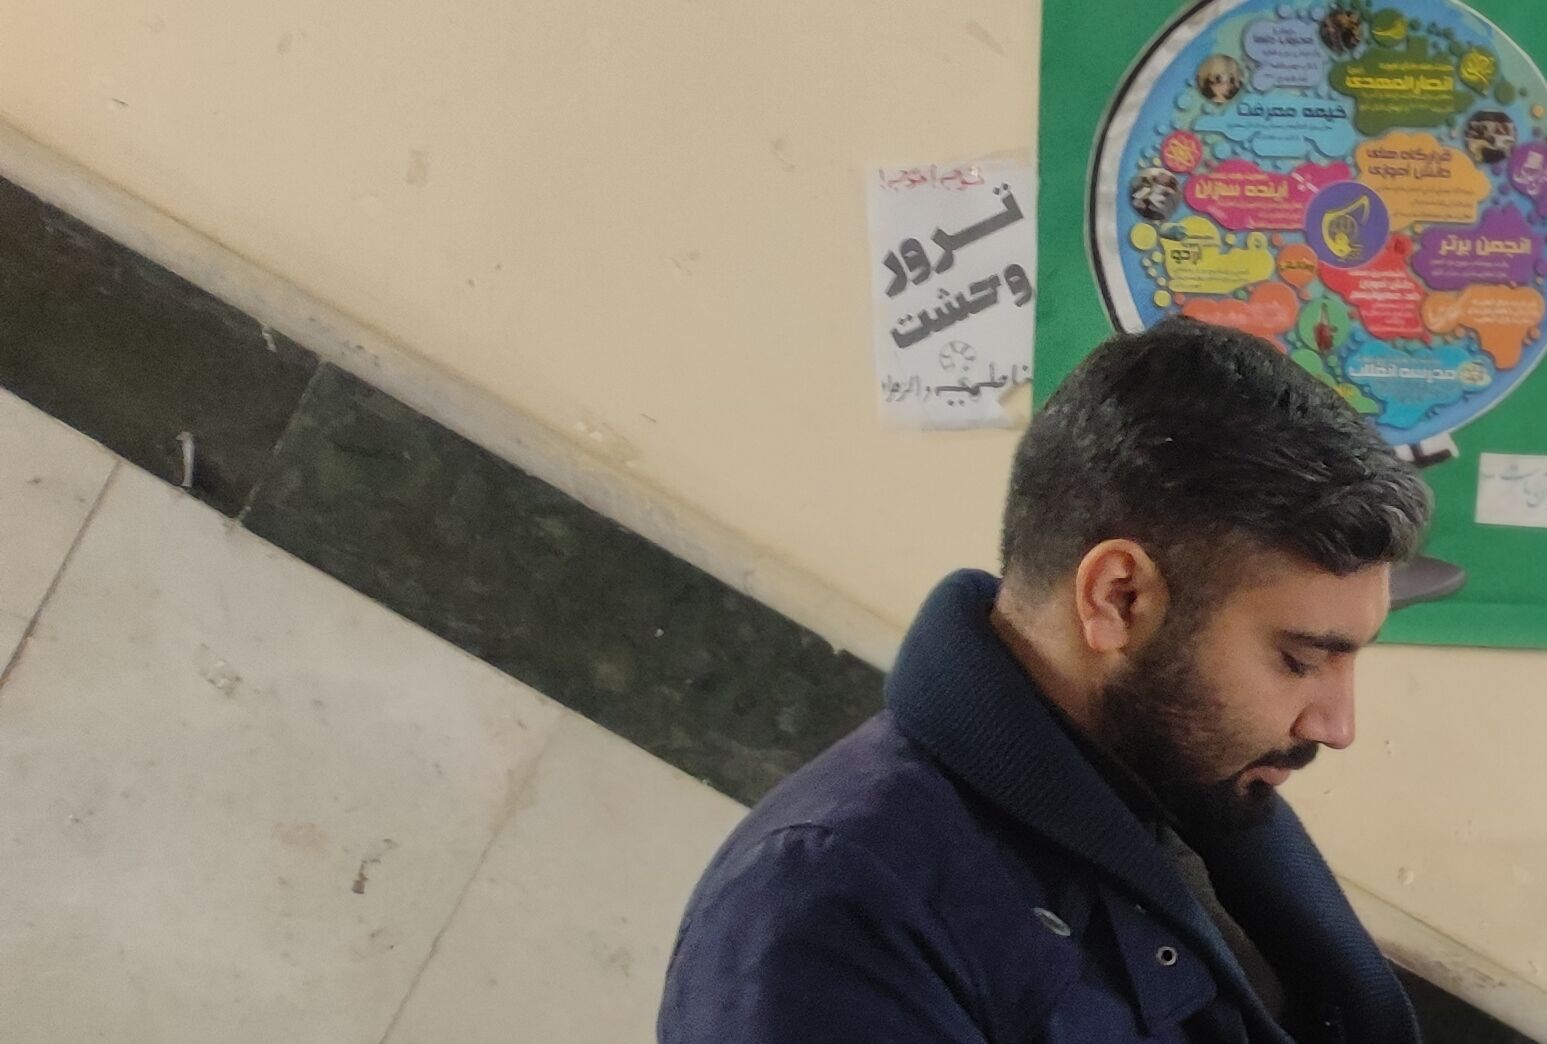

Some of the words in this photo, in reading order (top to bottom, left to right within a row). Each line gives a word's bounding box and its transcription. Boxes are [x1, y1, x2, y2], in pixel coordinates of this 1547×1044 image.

[1236, 101, 1298, 121] معرفت
[1302, 105, 1347, 122] خیمه
[882, 182, 1025, 298] ترور
[1440, 235, 1471, 256] برتر
[1476, 237, 1531, 258] انجمن
[890, 263, 1033, 349] وحشت
[1348, 365, 1398, 378] انقلاب
[1398, 368, 1457, 384] مدرسه
